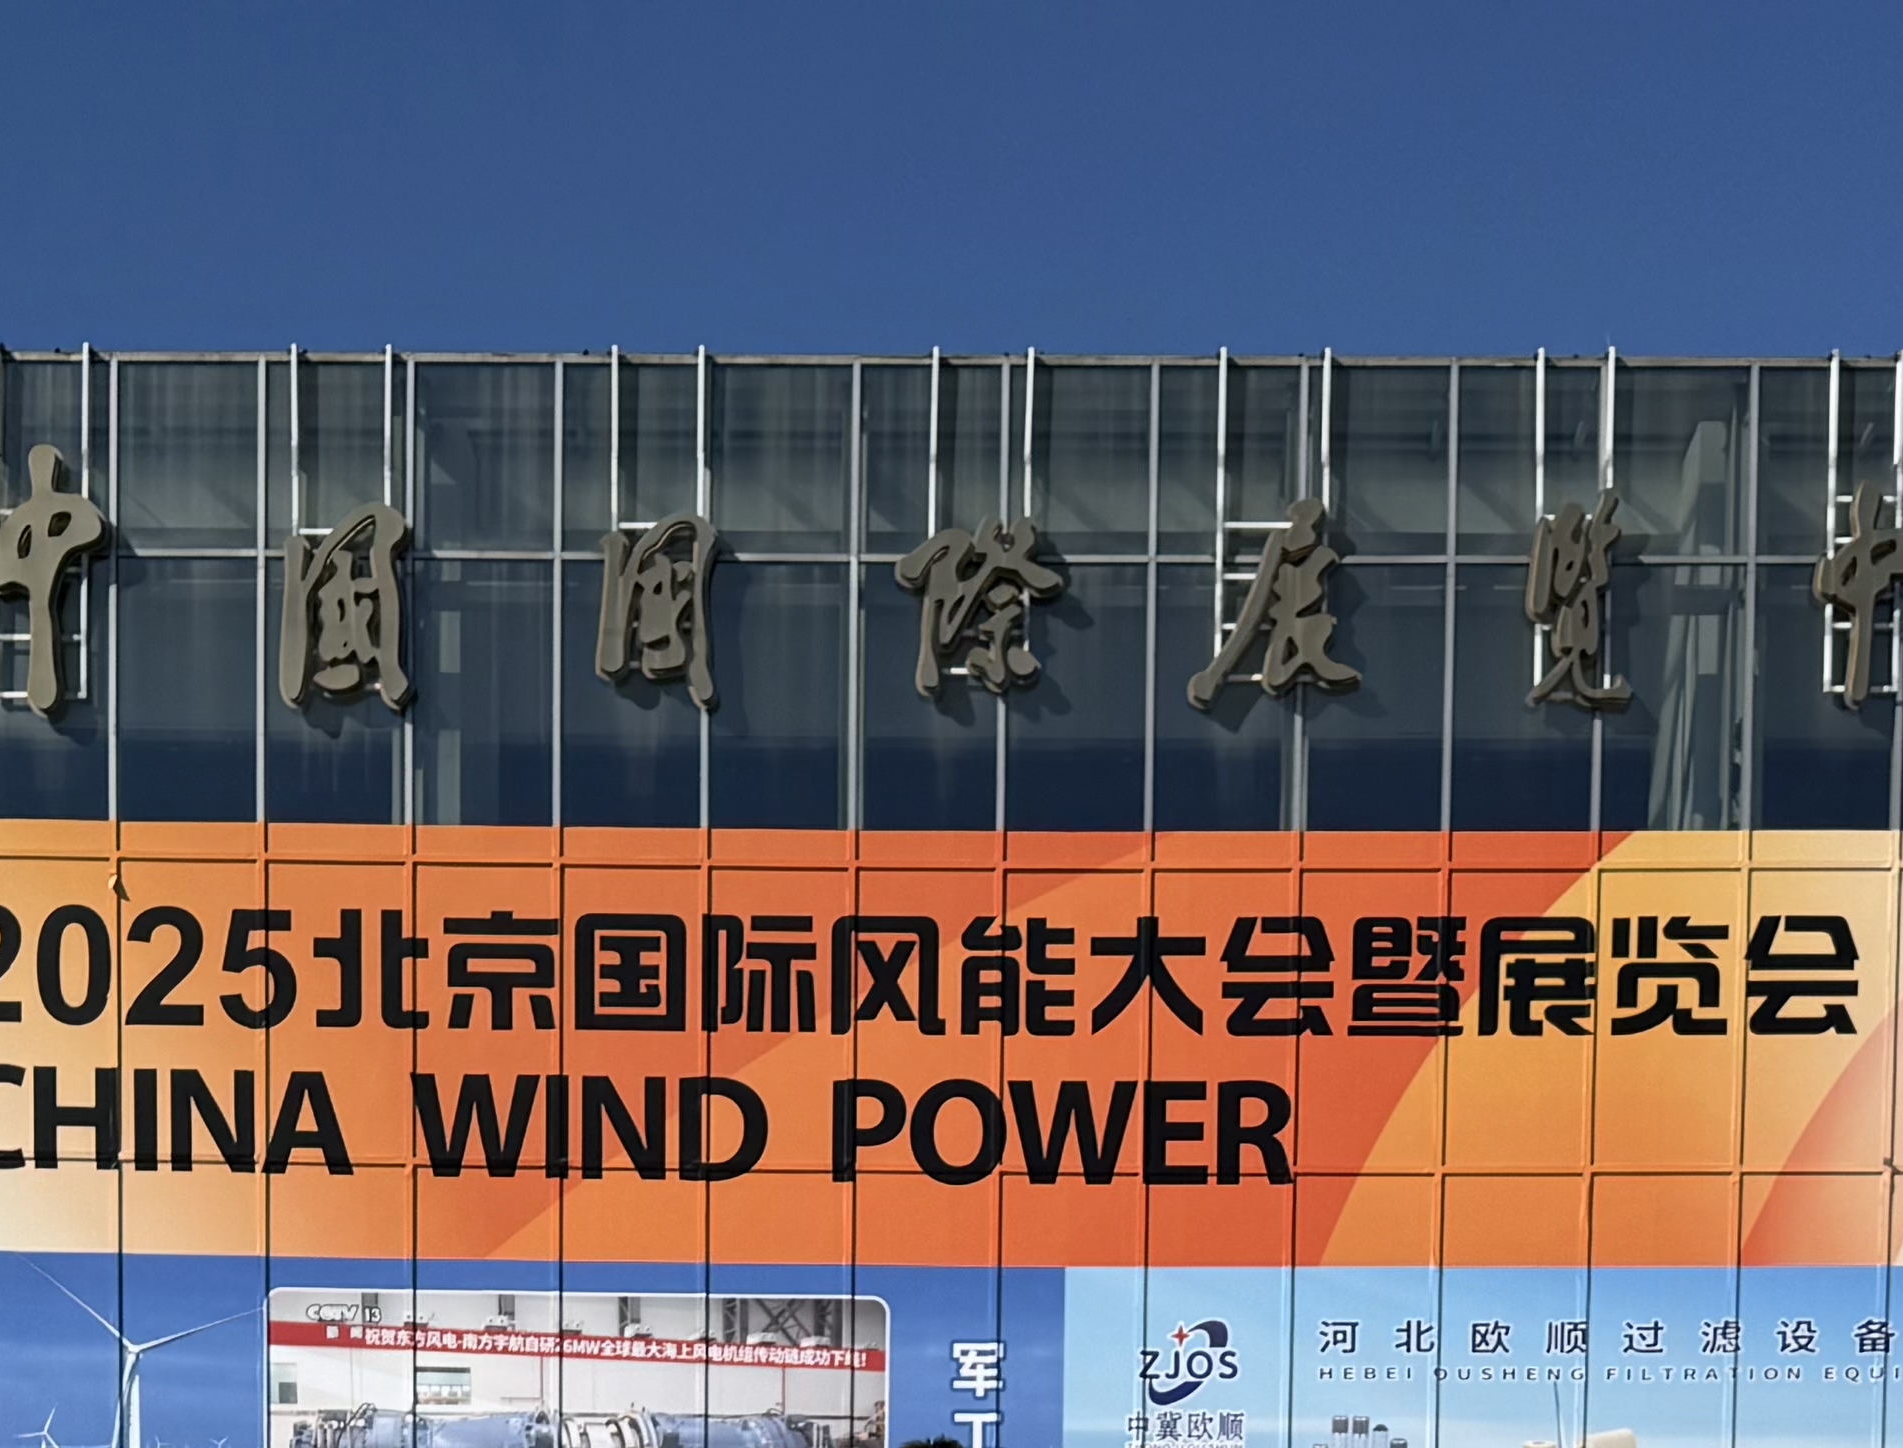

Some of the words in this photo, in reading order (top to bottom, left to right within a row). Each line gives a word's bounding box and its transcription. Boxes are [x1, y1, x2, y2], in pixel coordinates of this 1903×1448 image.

[410, 1073, 768, 1183] WIND
[832, 1078, 1294, 1186] POWER
[1139, 1350, 1239, 1379] ZJOS
[1320, 1367, 1412, 1380] HEBEI
[1606, 1367, 1800, 1380] FILTRATION
[1128, 1411, 1245, 1441] 中冀欧顺
